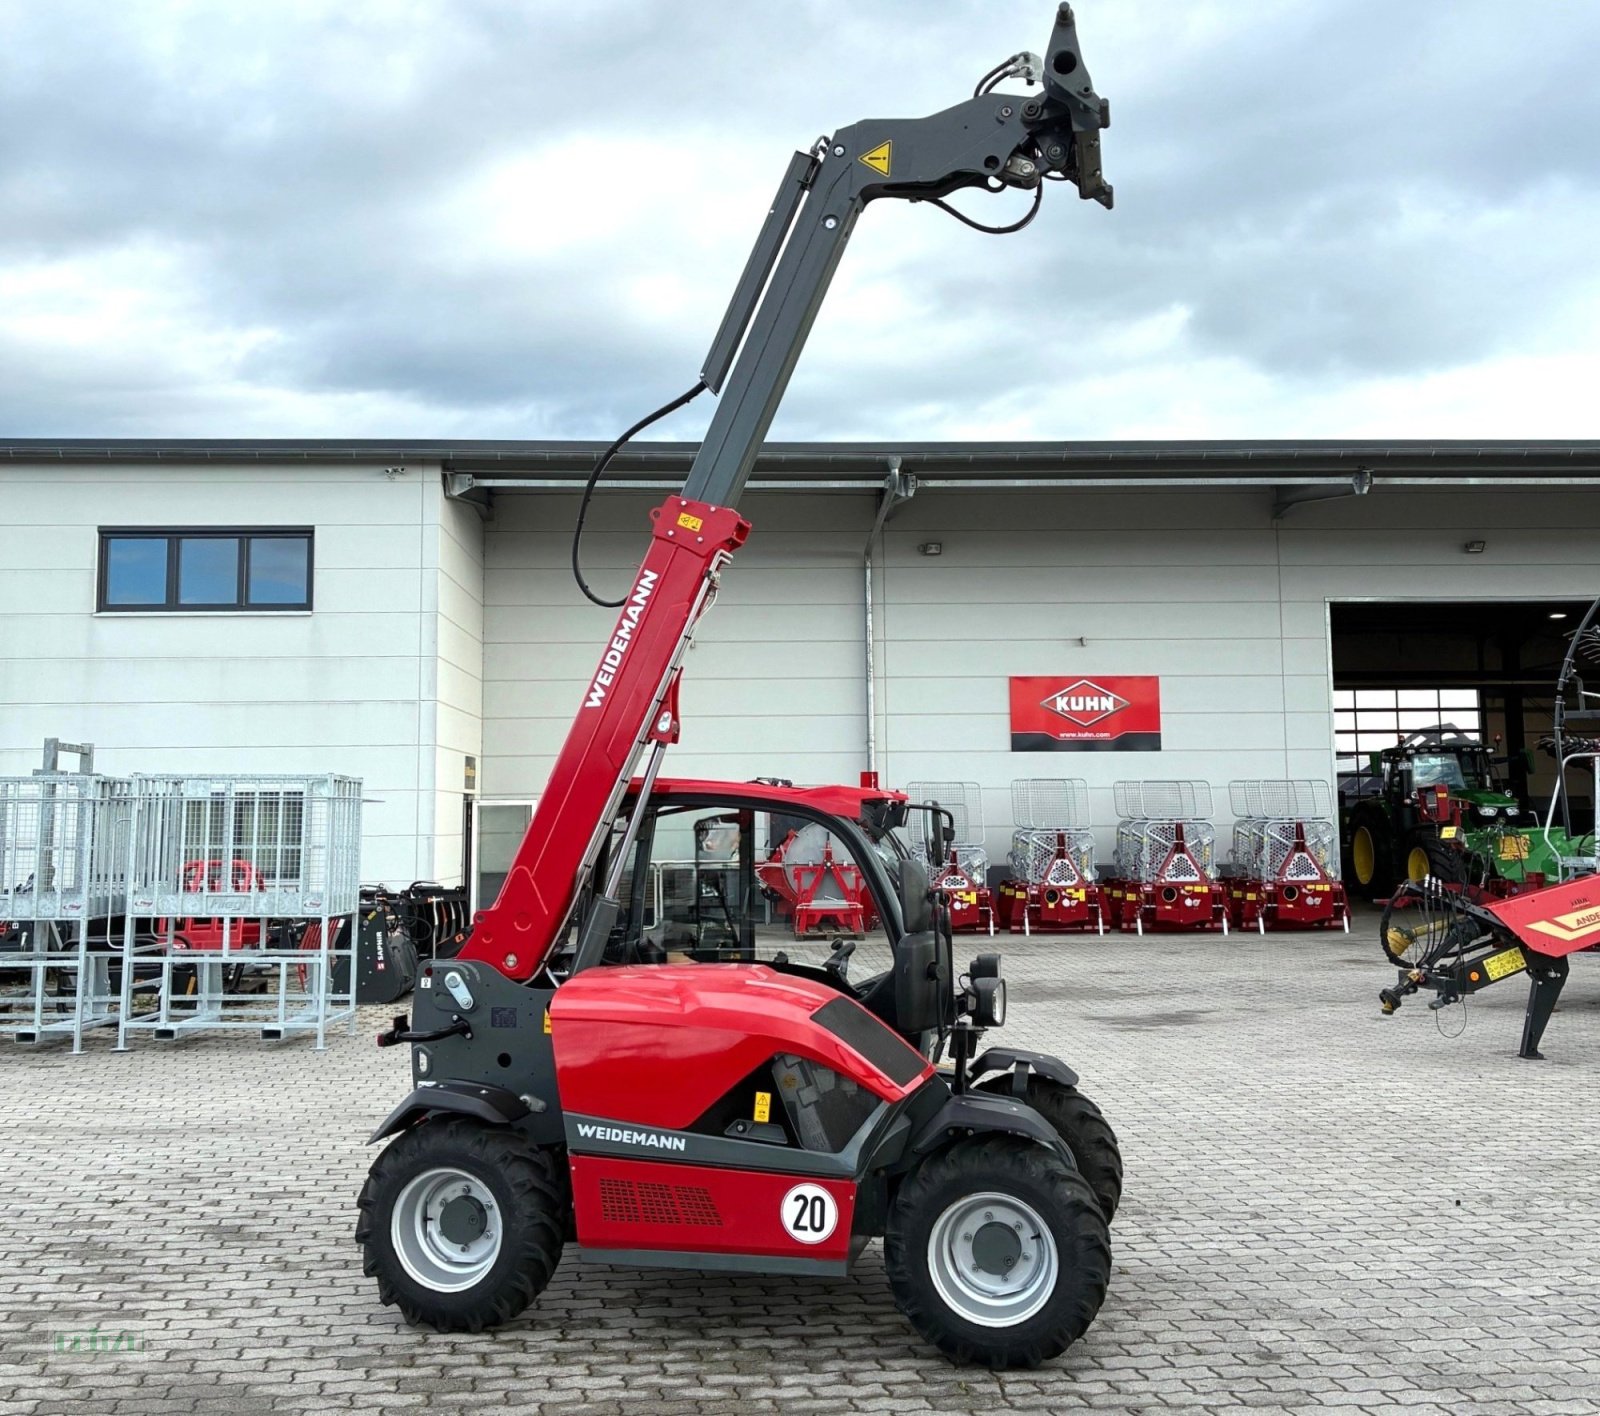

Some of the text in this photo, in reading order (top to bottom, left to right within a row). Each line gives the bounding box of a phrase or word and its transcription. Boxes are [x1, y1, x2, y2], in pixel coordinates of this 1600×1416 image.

[585, 569, 659, 708] WEIDEMANN
[1056, 696, 1114, 711] KUHN
[1059, 731, 1110, 739] www.kuhn.com
[375, 931, 384, 961] SAPHIR
[577, 1123, 686, 1152] WEIDEMANN
[792, 1194, 826, 1233] 20
